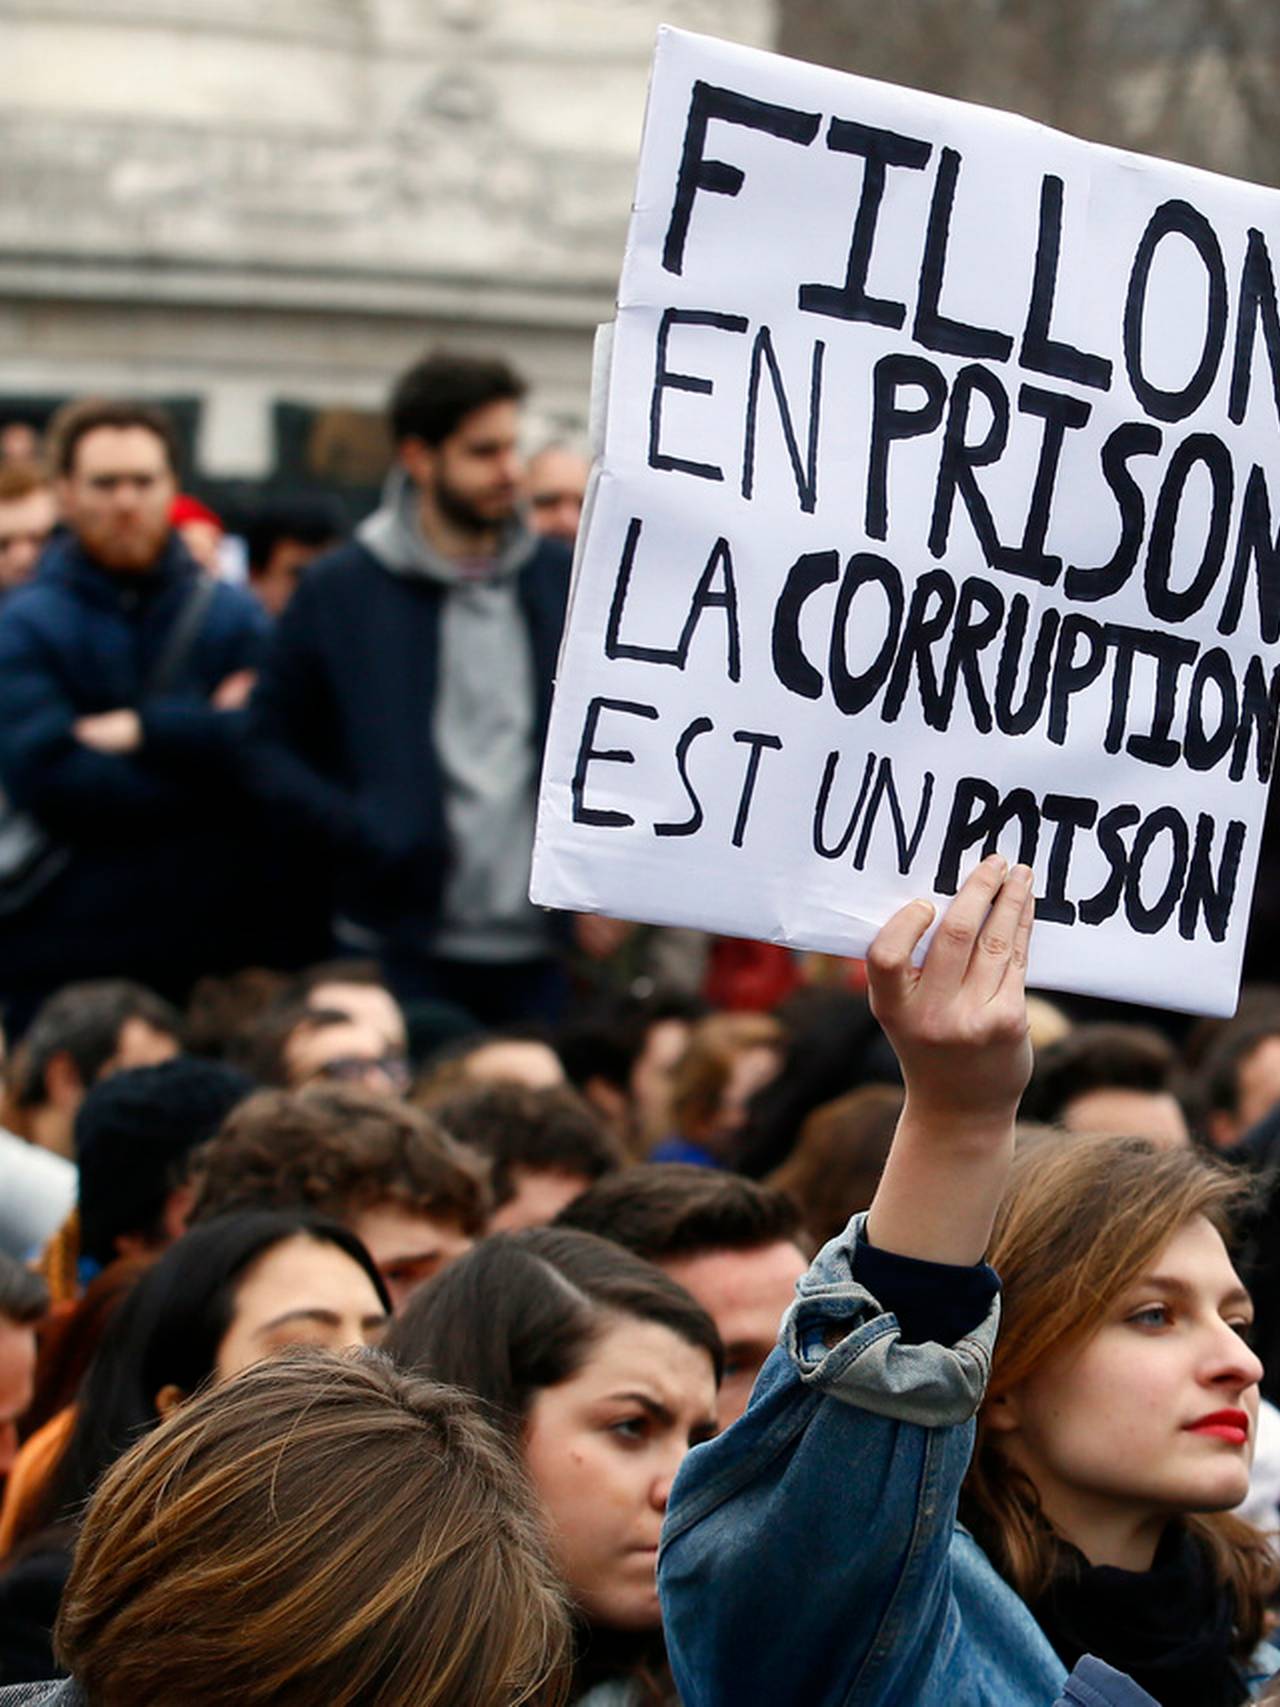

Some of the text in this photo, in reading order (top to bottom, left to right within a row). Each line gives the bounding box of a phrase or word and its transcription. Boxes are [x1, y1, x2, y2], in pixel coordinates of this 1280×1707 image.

[648, 306, 826, 515] EN
[604, 517, 741, 684] LA
[571, 696, 1247, 943] EST UN POISON
